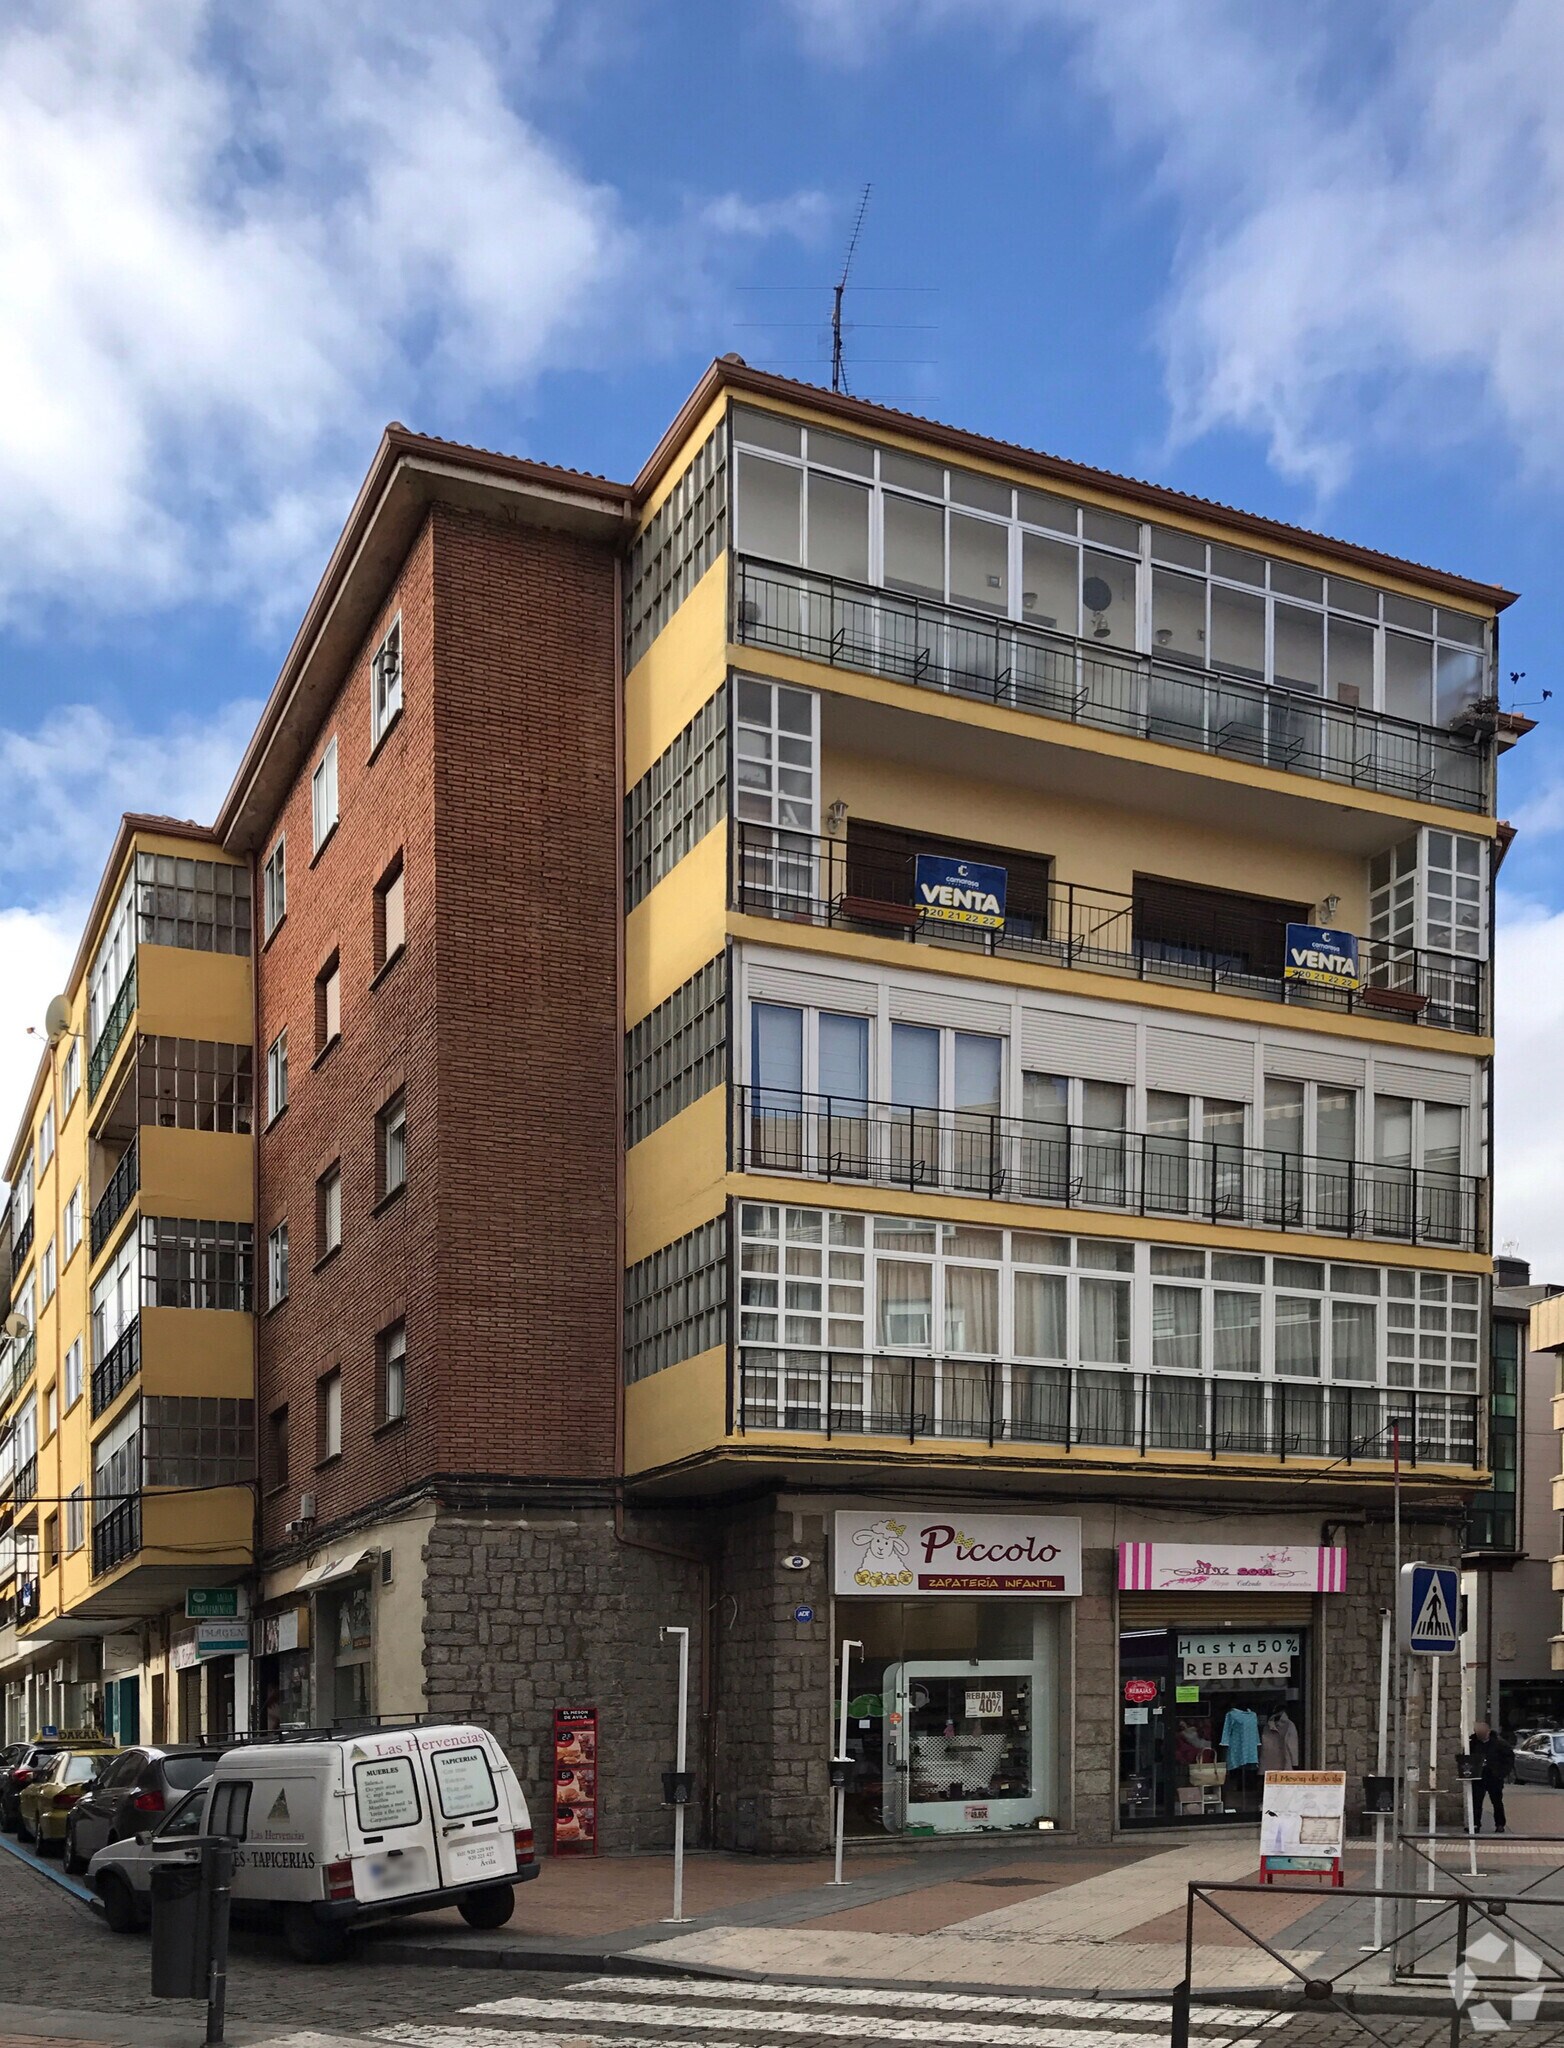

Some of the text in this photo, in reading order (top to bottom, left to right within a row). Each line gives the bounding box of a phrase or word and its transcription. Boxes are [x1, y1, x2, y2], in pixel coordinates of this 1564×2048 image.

[920, 883, 1000, 914] VENTA
[948, 911, 961, 920] 21
[965, 914, 979, 923] 22
[982, 916, 996, 926] 22
[1290, 948, 1356, 977] VENTA
[1314, 973, 1325, 981] 21
[1328, 975, 1339, 984] 22
[1341, 979, 1353, 987] 22
[920, 1525, 1061, 1563] Piccolo
[1194, 1566, 1230, 1576] PINK
[928, 1576, 1056, 1588] ZAPATERÍA INFANTIL
[798, 1610, 810, 1618] ADT
[201, 1628, 246, 1637] IMAGEN
[1186, 1661, 1290, 1676] REBAJAS
[966, 1691, 1002, 1700] REBAJAS
[978, 1699, 1001, 1713] 40%
[58, 1730, 99, 1740] DAKAR
[375, 1734, 485, 1757] Las Hervencias
[441, 1755, 478, 1766] TAPICERIAS
[366, 1766, 399, 1777] MUEBLES
[250, 1830, 305, 1841] Las Hervencias
[252, 1851, 315, 1869] TAPICERIAS
[480, 1858, 497, 1867] Ávila
